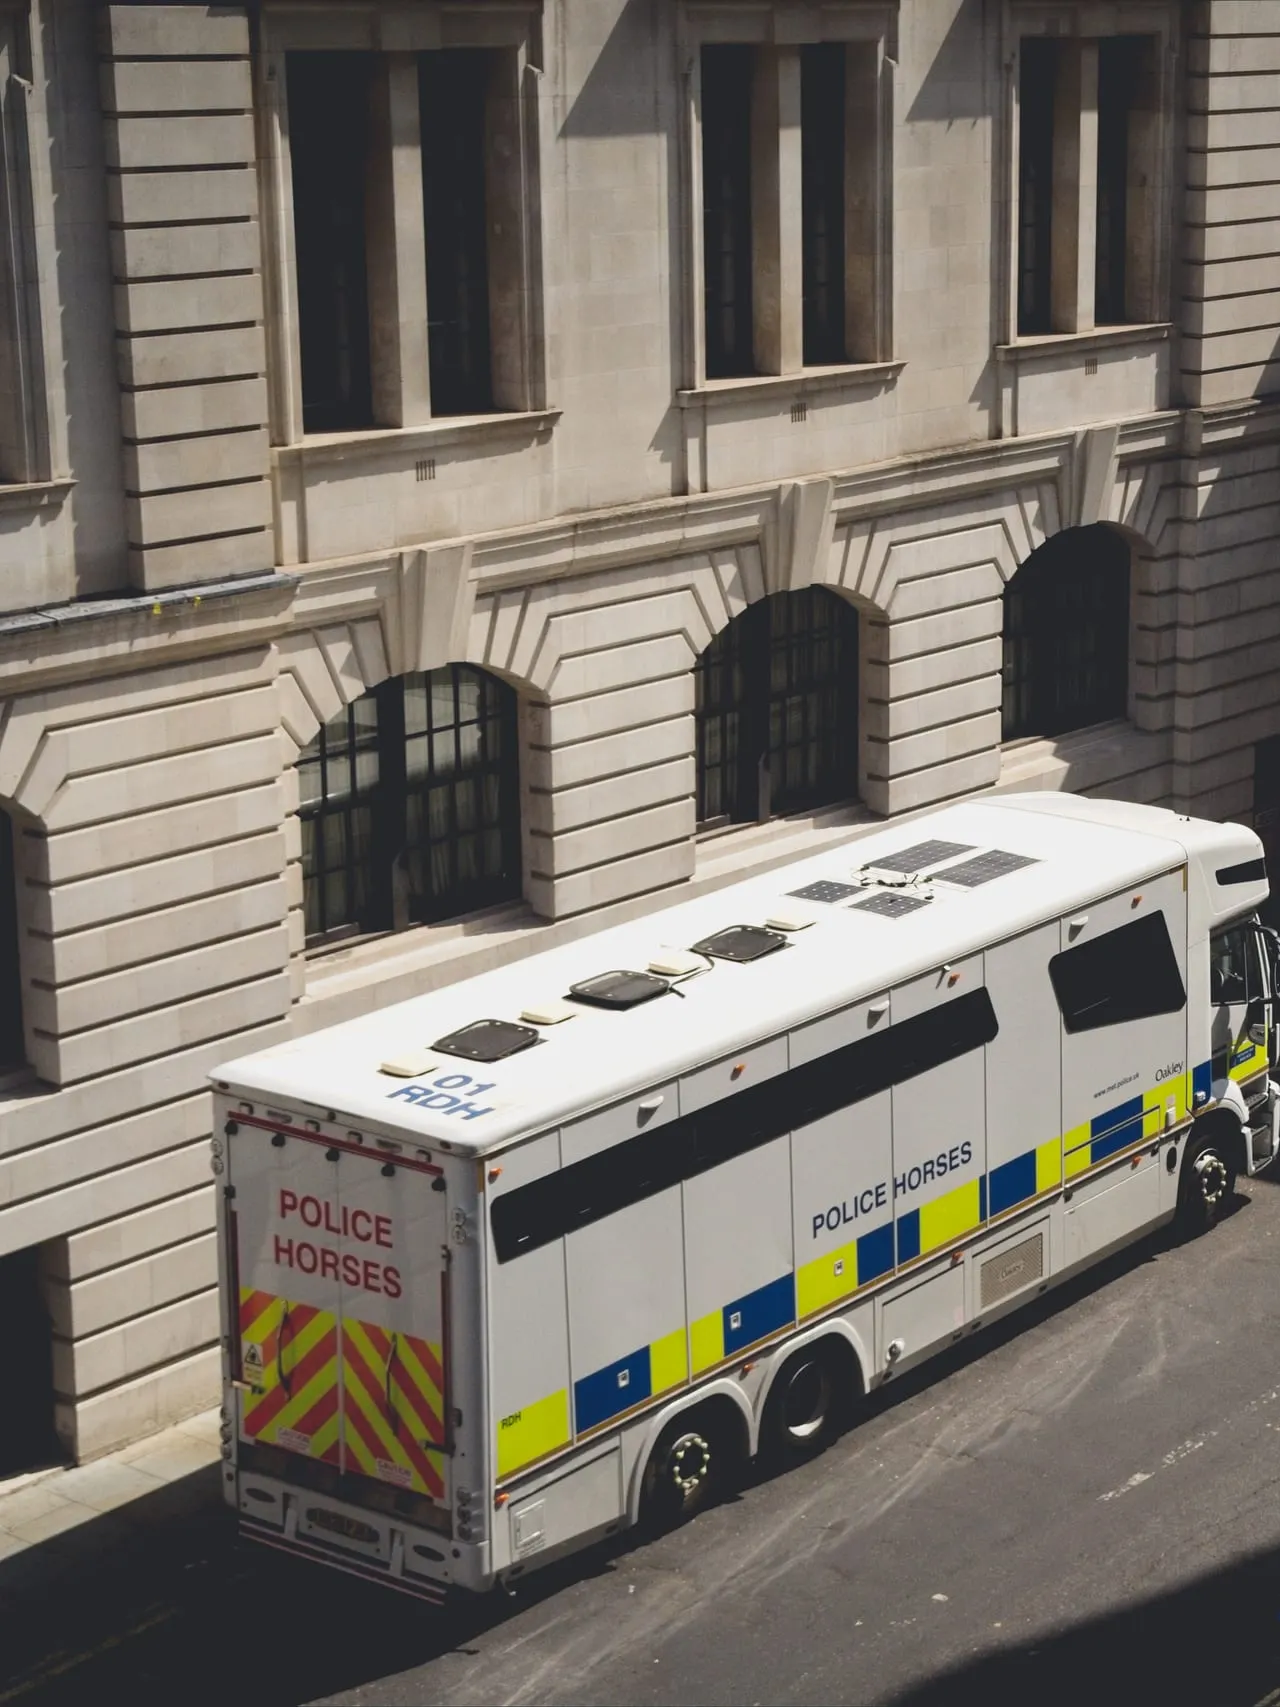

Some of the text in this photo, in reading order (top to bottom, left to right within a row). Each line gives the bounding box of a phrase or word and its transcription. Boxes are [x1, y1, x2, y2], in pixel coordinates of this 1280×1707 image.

[1155, 1061, 1184, 1082] Oakley
[385, 1085, 496, 1121] RDH
[812, 1141, 972, 1239] POLICE HORSES
[279, 1188, 394, 1249] POLICE
[273, 1234, 402, 1299] HORSES
[500, 1411, 522, 1429] RDH
